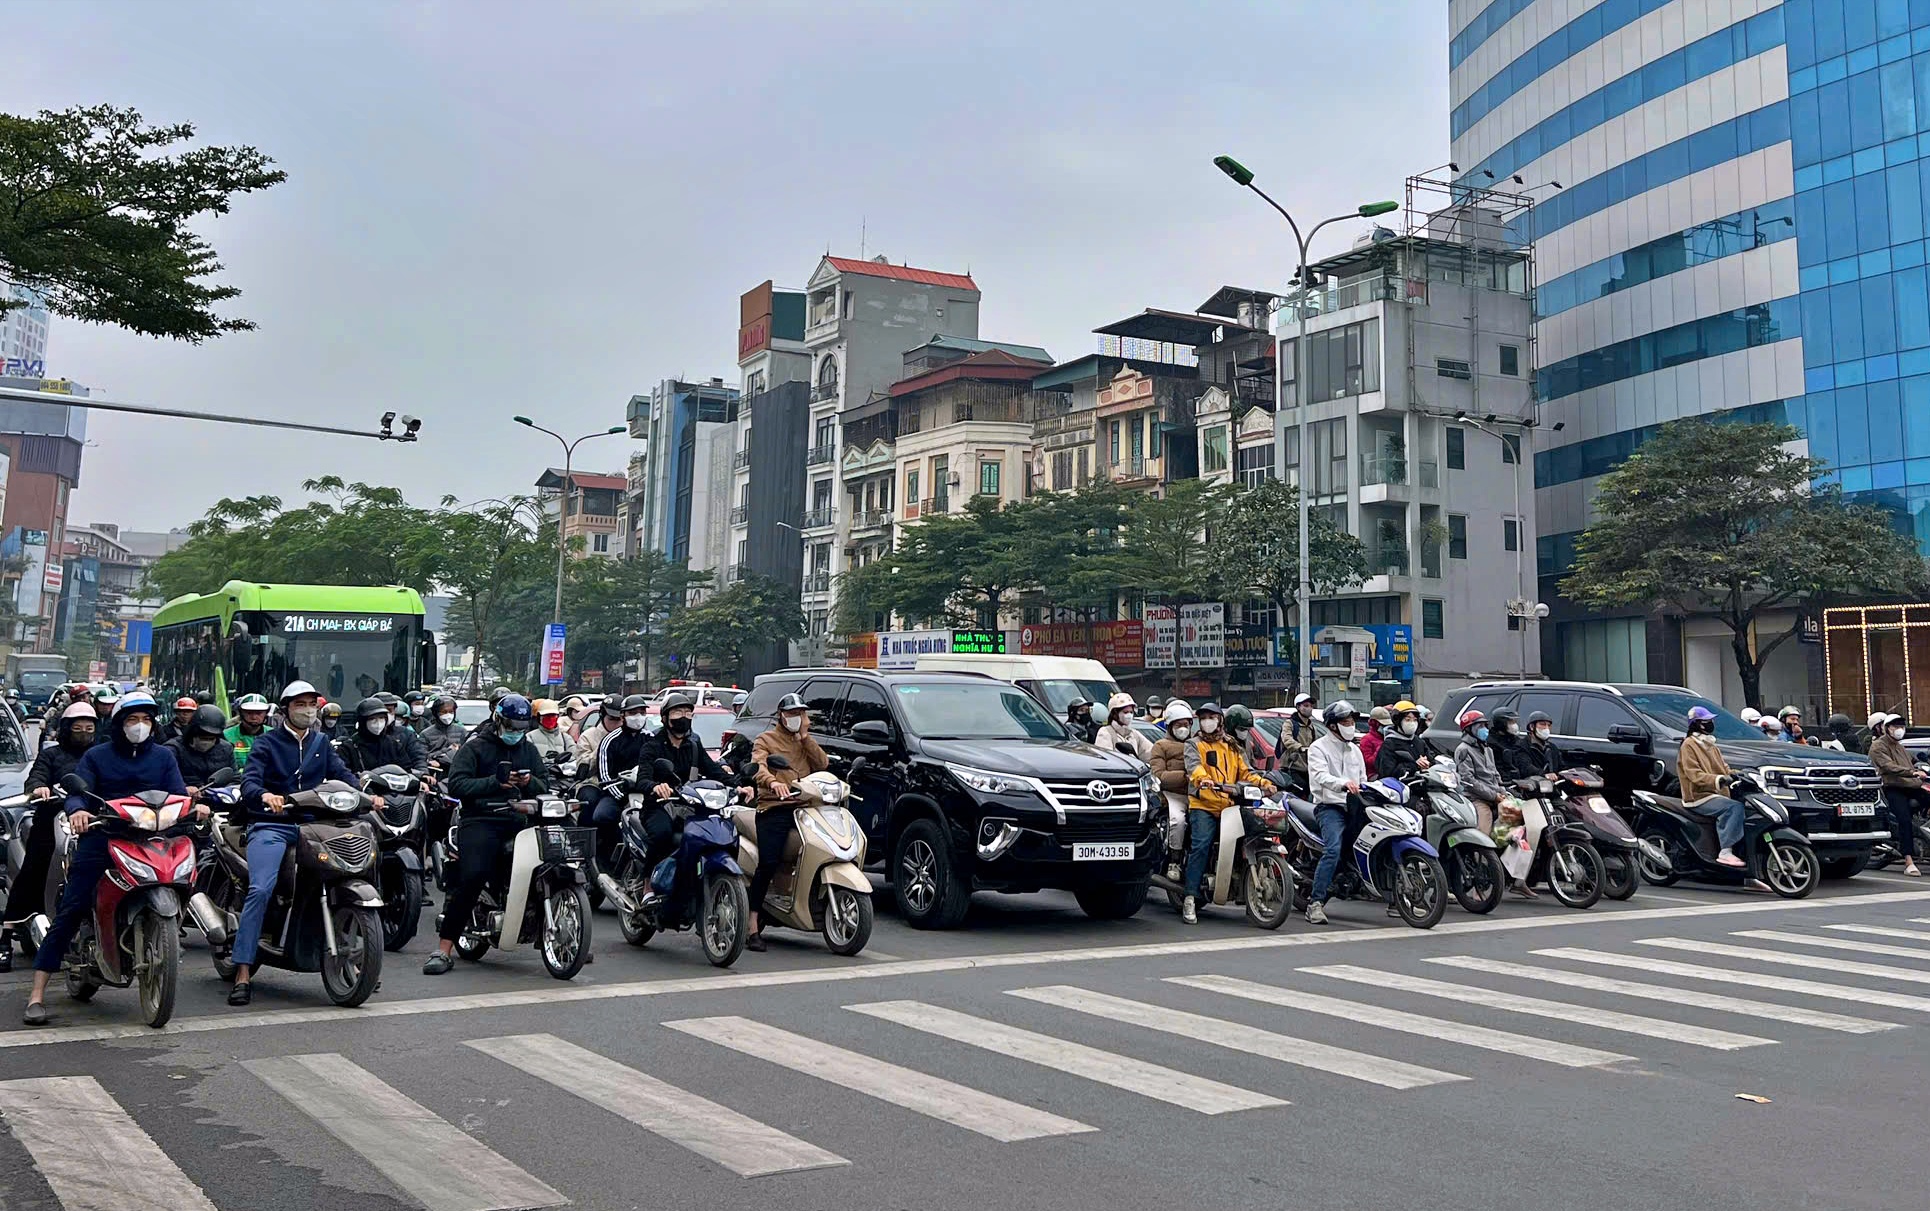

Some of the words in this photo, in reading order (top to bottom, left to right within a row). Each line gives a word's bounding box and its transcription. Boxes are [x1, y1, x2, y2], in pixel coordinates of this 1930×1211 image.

[6, 358, 43, 375] PVI
[284, 615, 305, 631] 21A
[306, 619, 318, 630] CH
[344, 619, 356, 631] BX
[955, 632, 973, 642] NHÀ
